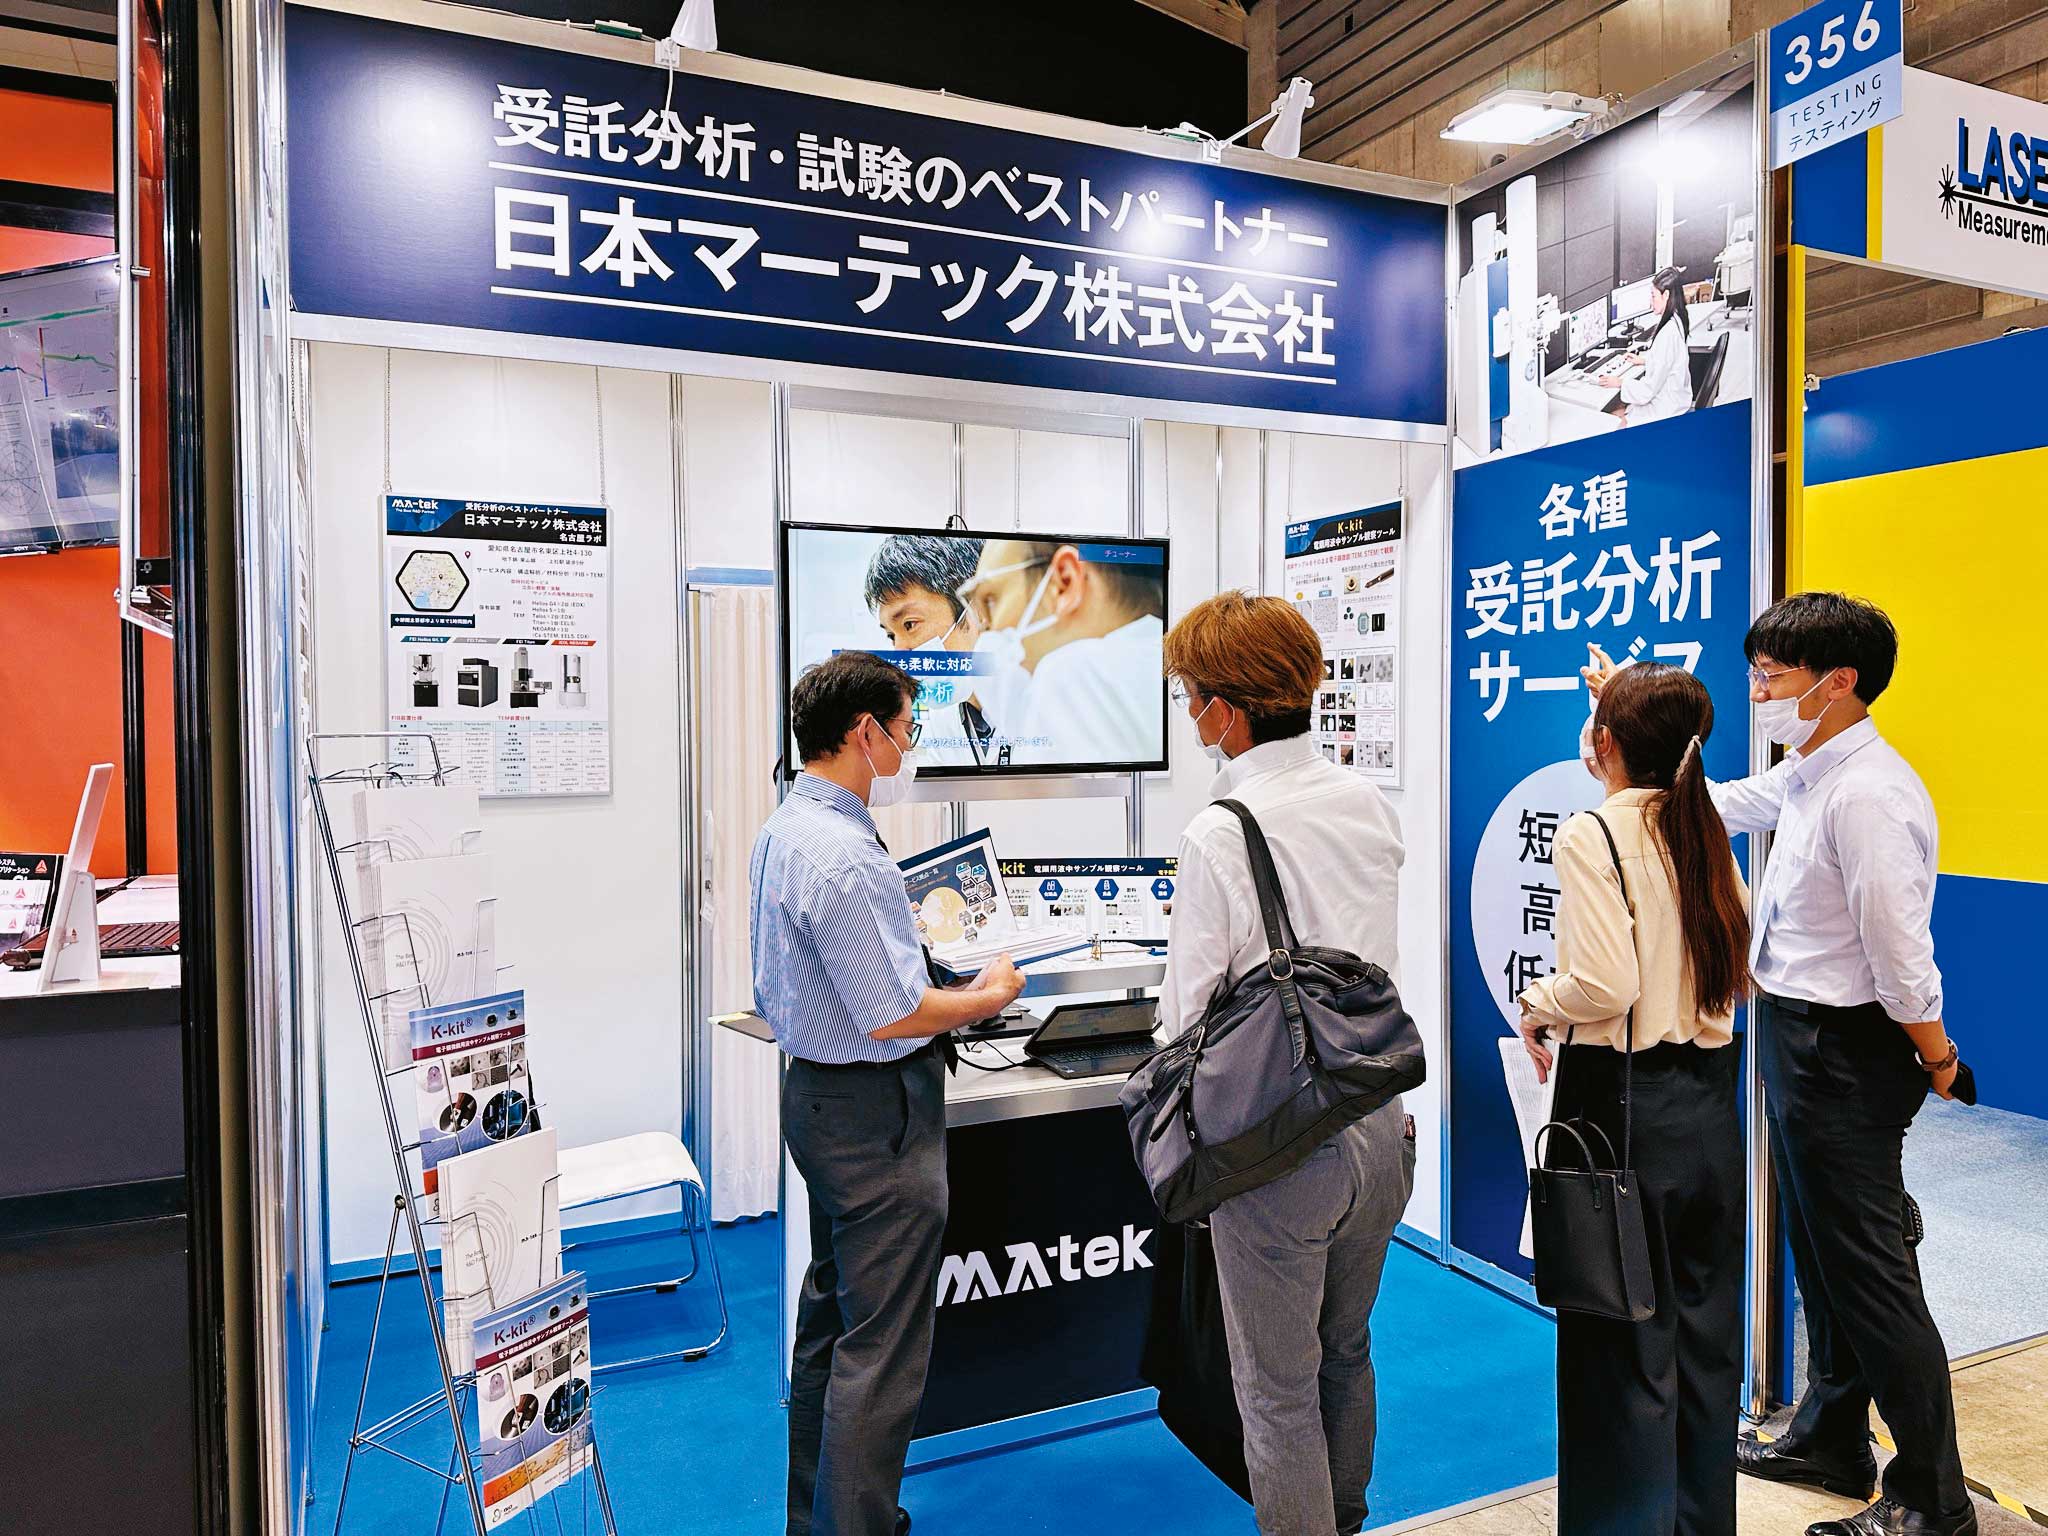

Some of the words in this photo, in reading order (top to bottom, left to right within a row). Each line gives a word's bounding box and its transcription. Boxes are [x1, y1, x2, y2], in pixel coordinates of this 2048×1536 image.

[1784, 0, 1881, 85] 356
[1789, 73, 1882, 127] TESTING
[1789, 97, 1882, 153] テスティング
[493, 84, 1329, 257] 受託分析・試験のベストパートナー
[1957, 200, 2048, 246] Measurem
[494, 186, 1336, 366] 日本マーテック株式会社
[464, 514, 603, 533] 日本マーテック株式会社
[465, 502, 569, 515] 受託分析のベストパートナー
[1337, 518, 1363, 534] K-kit
[1538, 469, 1628, 540] 各種
[559, 533, 602, 544] 名古屋ラボ
[1104, 549, 1137, 558] チューナー
[1465, 530, 1721, 640] 受託分析
[1519, 808, 1570, 864] 短
